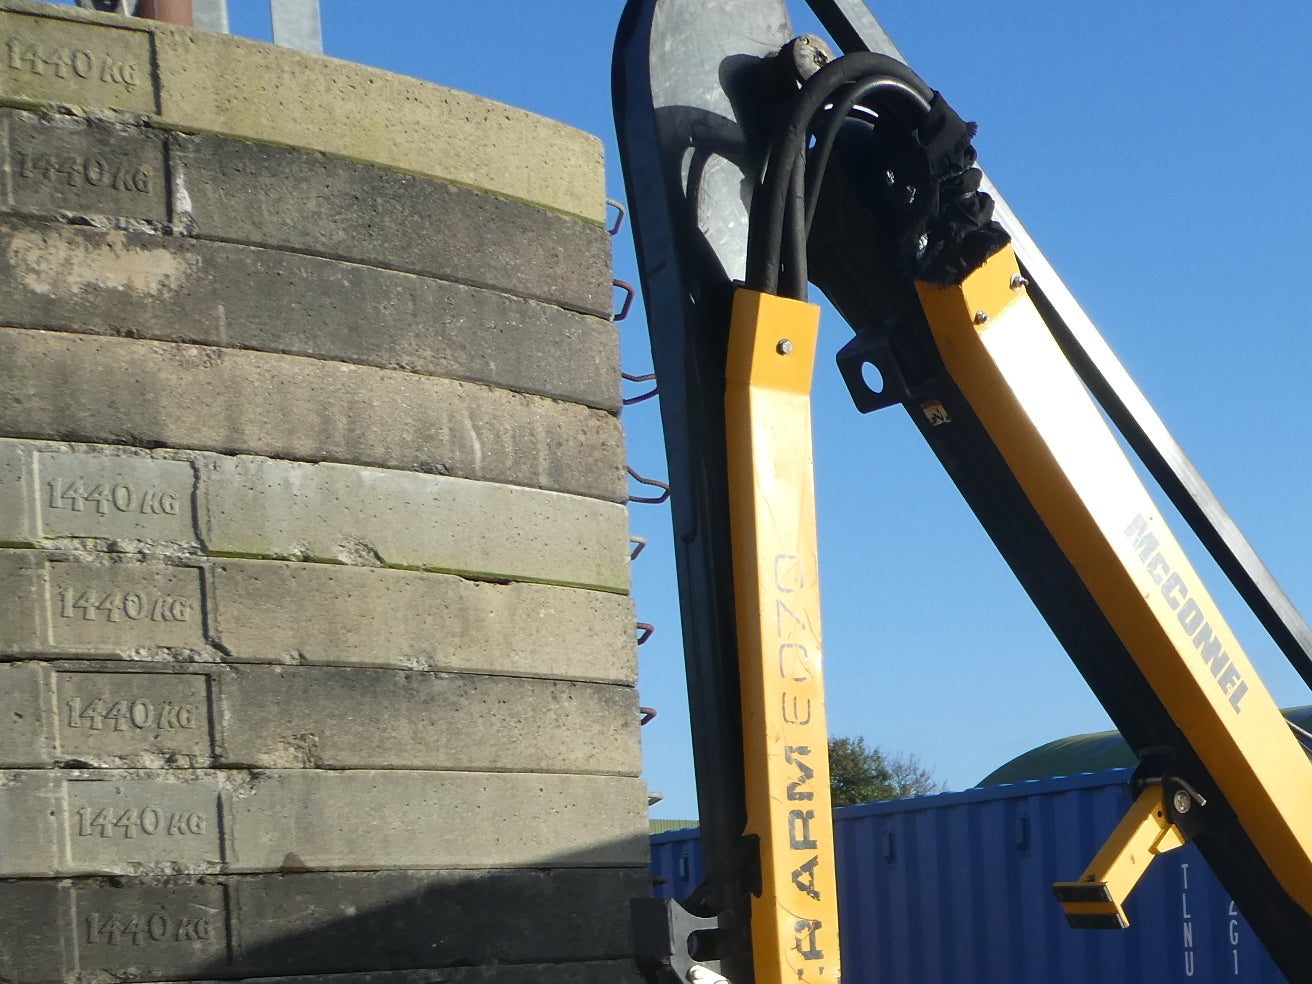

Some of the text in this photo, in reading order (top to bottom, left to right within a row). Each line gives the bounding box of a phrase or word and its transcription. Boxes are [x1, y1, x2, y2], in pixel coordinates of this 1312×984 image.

[6, 37, 94, 79] 1440
[48, 478, 180, 515] 1440 KG
[60, 587, 190, 622] 1440 KG
[1124, 512, 1249, 714] McCONNEL
[67, 697, 196, 732] 1440 KG
[77, 806, 206, 839] 1440 KG
[85, 912, 214, 945] 1440 KG
[1181, 863, 1194, 976] TLNU
